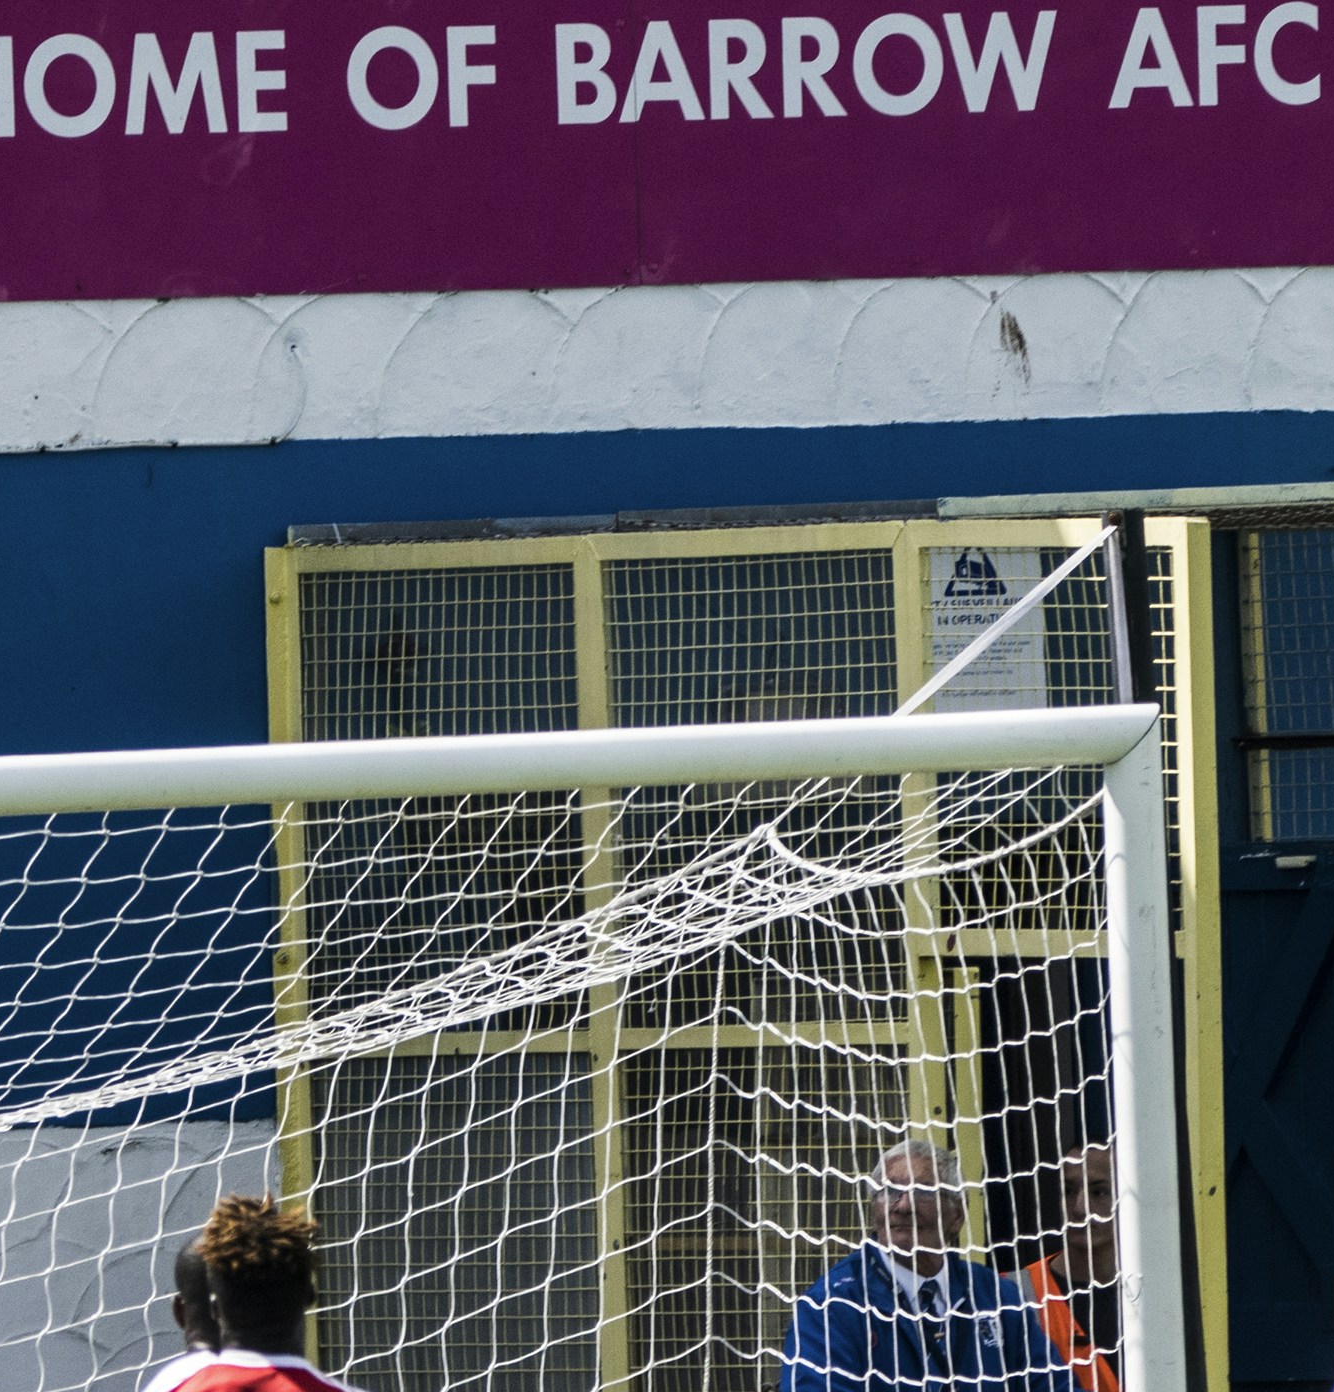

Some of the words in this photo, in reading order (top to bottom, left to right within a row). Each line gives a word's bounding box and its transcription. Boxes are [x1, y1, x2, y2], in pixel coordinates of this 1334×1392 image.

[347, 25, 496, 130] OF
[554, 9, 1057, 125] BARROW
[1107, 1, 1321, 109] AFC
